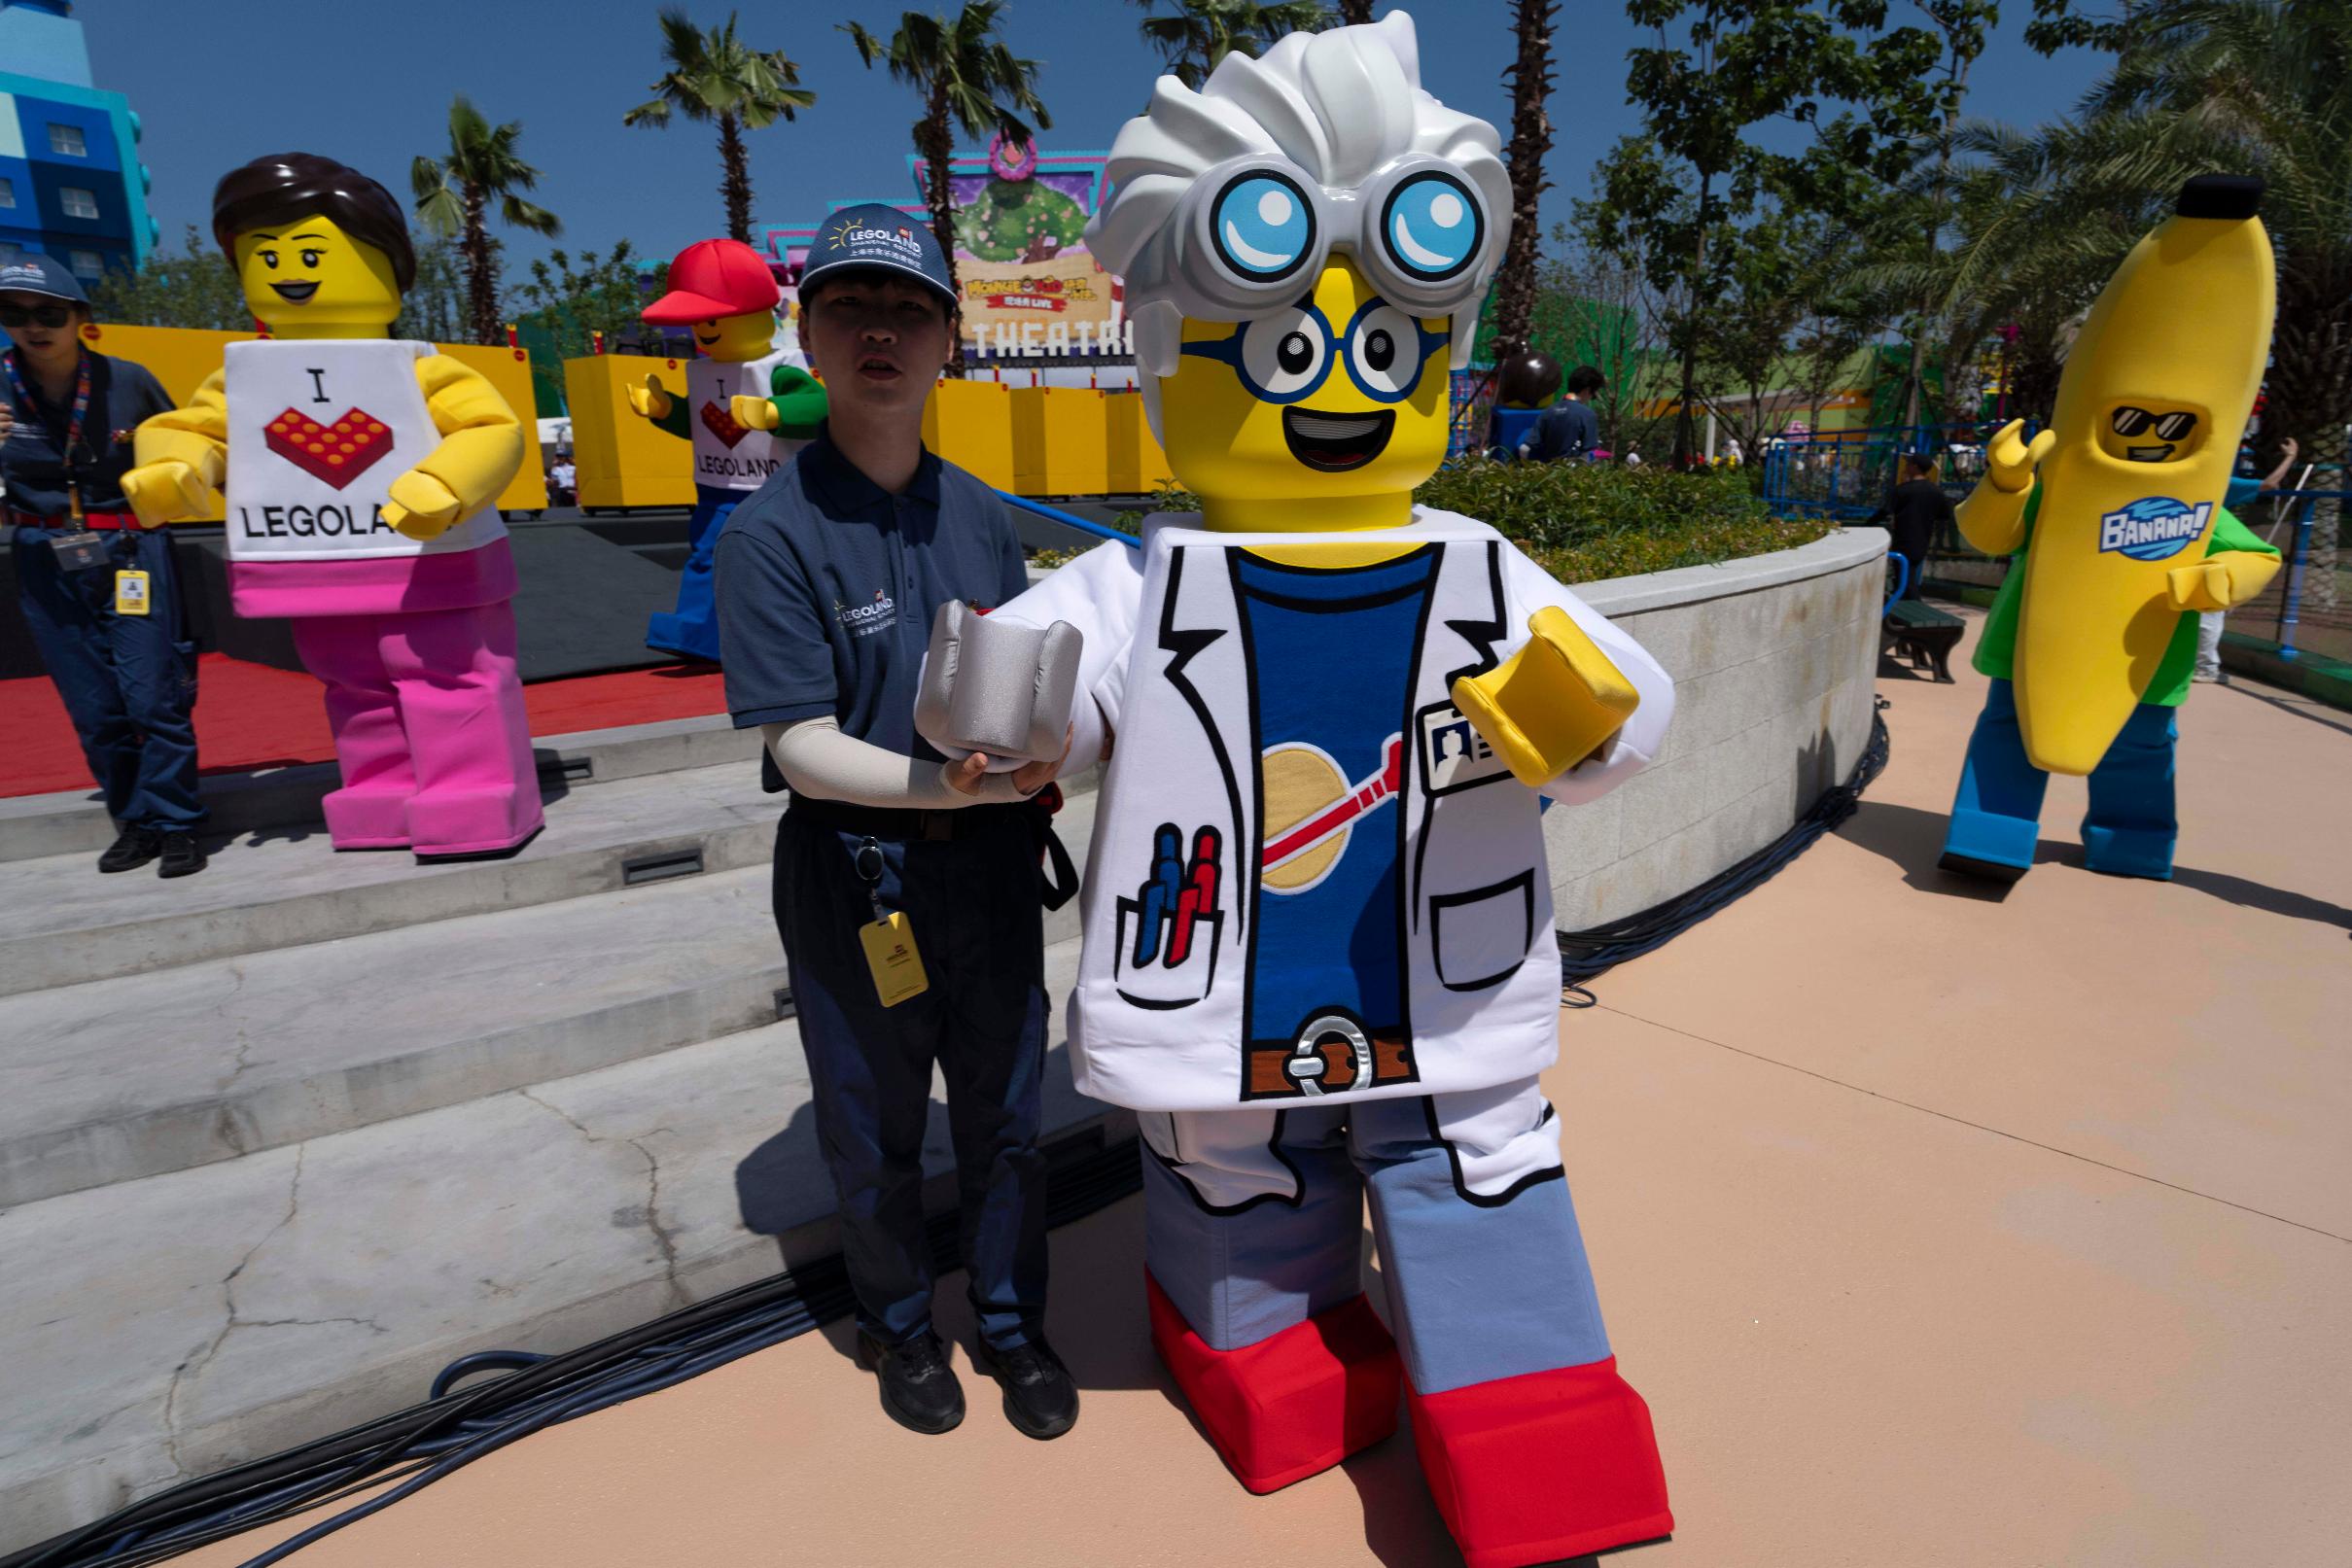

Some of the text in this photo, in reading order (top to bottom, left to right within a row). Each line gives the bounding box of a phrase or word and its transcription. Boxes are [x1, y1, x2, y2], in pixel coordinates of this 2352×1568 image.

[850, 229, 922, 253] LEGOLAND
[306, 368, 331, 402] I
[717, 379, 725, 400] I
[240, 504, 451, 538] LEGOLA
[2100, 504, 2212, 550] BANANA!
